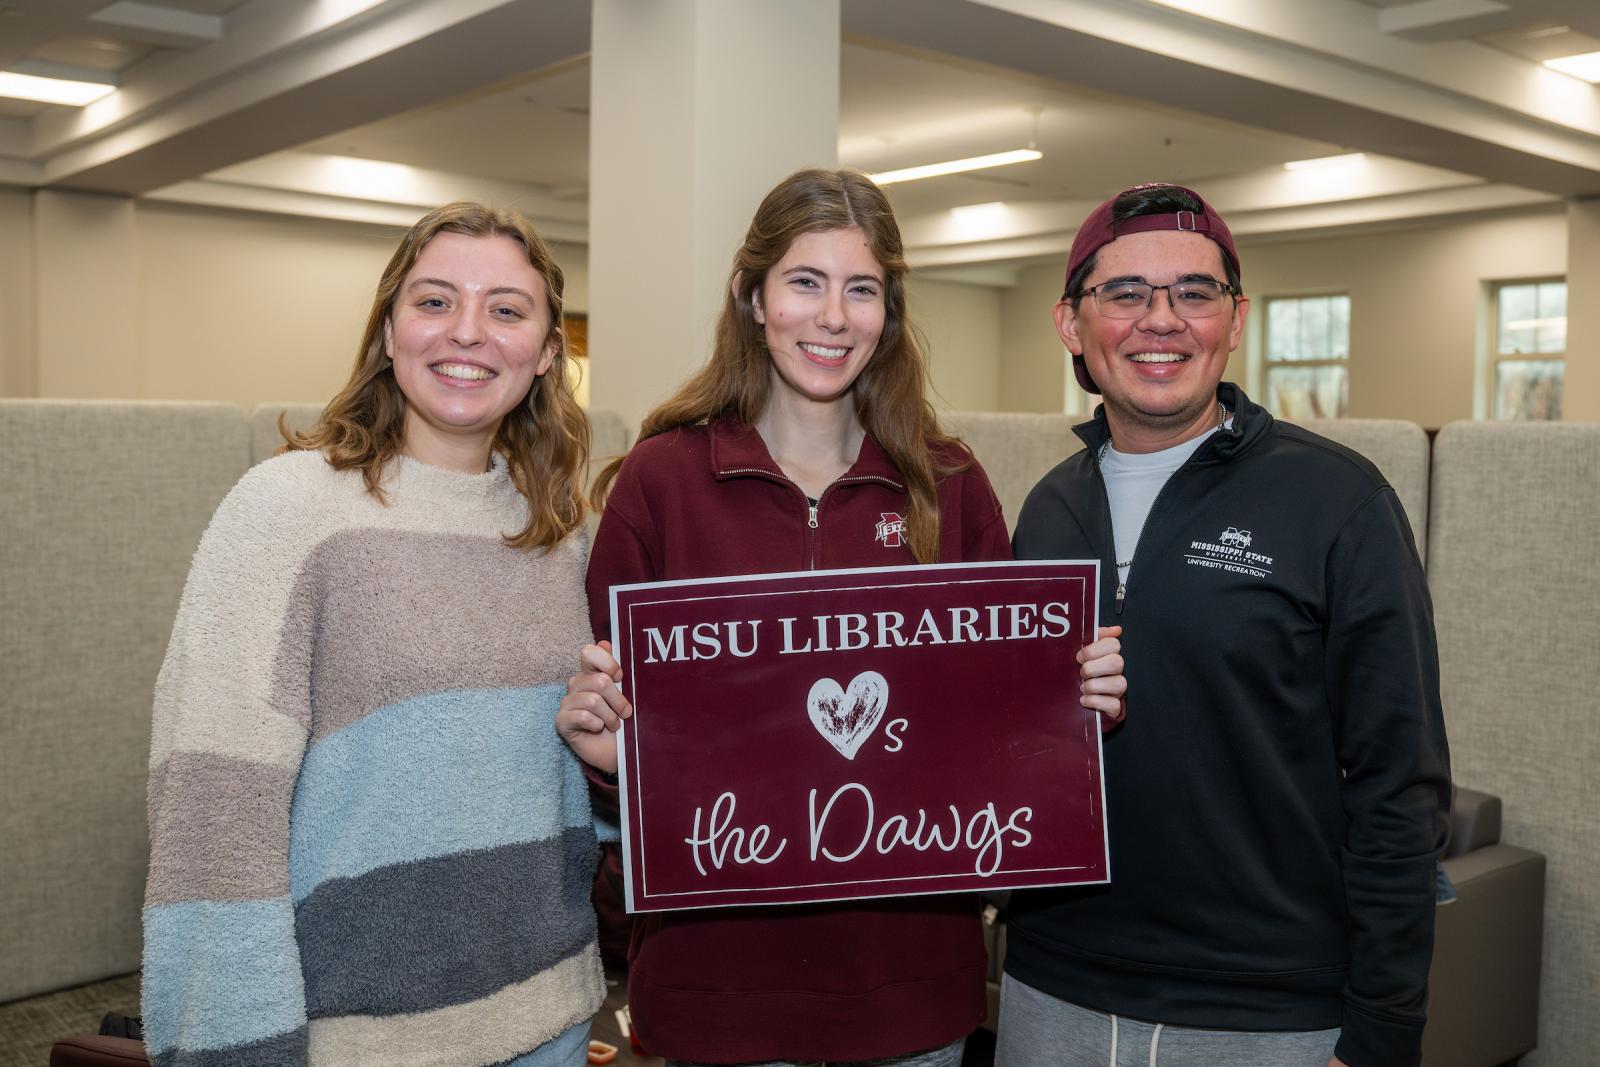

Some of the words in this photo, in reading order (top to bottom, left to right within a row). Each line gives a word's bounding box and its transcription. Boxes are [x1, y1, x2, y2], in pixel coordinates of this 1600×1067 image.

[1190, 541, 1243, 557] MISSISSIPPI
[1245, 551, 1273, 565] STATE
[1205, 551, 1252, 564] UNIVERSITY
[1187, 558, 1223, 569] UNIVERSITY
[1224, 564, 1266, 578] RECREATION
[643, 619, 763, 664] MSU
[777, 602, 1071, 655] LIBRARIES
[684, 791, 787, 877] the
[808, 782, 1034, 878] Dawgs
